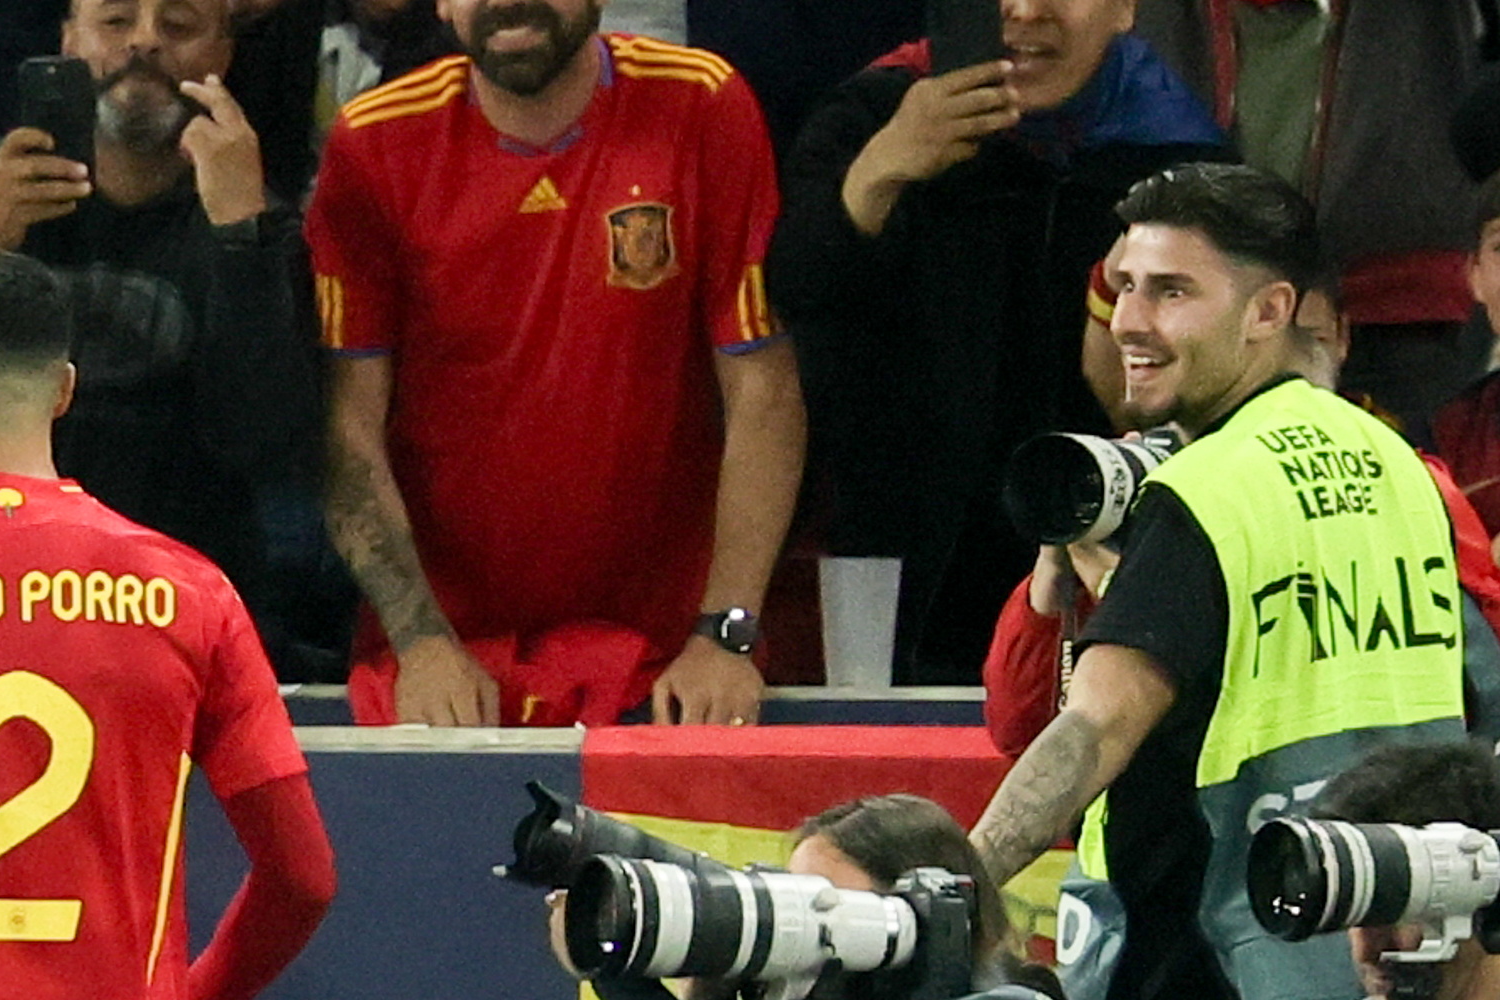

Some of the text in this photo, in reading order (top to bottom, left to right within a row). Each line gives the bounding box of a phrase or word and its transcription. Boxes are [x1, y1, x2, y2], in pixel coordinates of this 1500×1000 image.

[1254, 423, 1336, 454] UEFA
[1296, 482, 1379, 521] LEAGE
[20, 568, 176, 628] PORRO
[1251, 556, 1457, 680] FINALS
